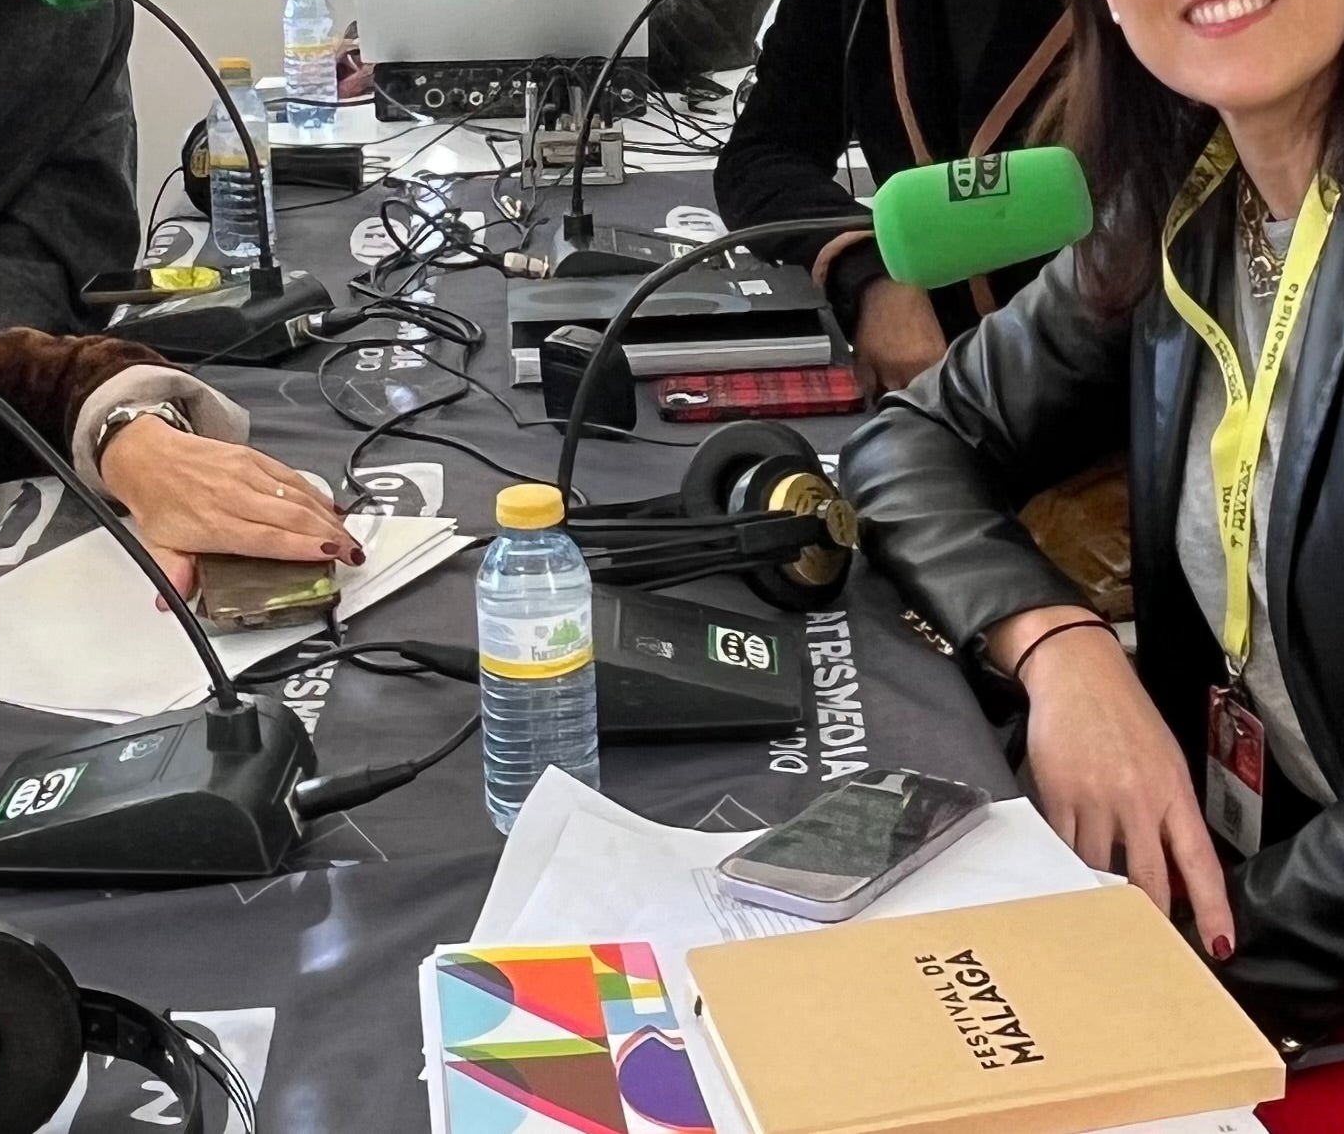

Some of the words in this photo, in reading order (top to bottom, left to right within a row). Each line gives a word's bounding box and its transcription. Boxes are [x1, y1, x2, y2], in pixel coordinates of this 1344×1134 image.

[914, 953, 945, 976] DE
[943, 948, 1045, 1066] MÁLAGA
[933, 981, 1006, 1070] FESTIVAL
